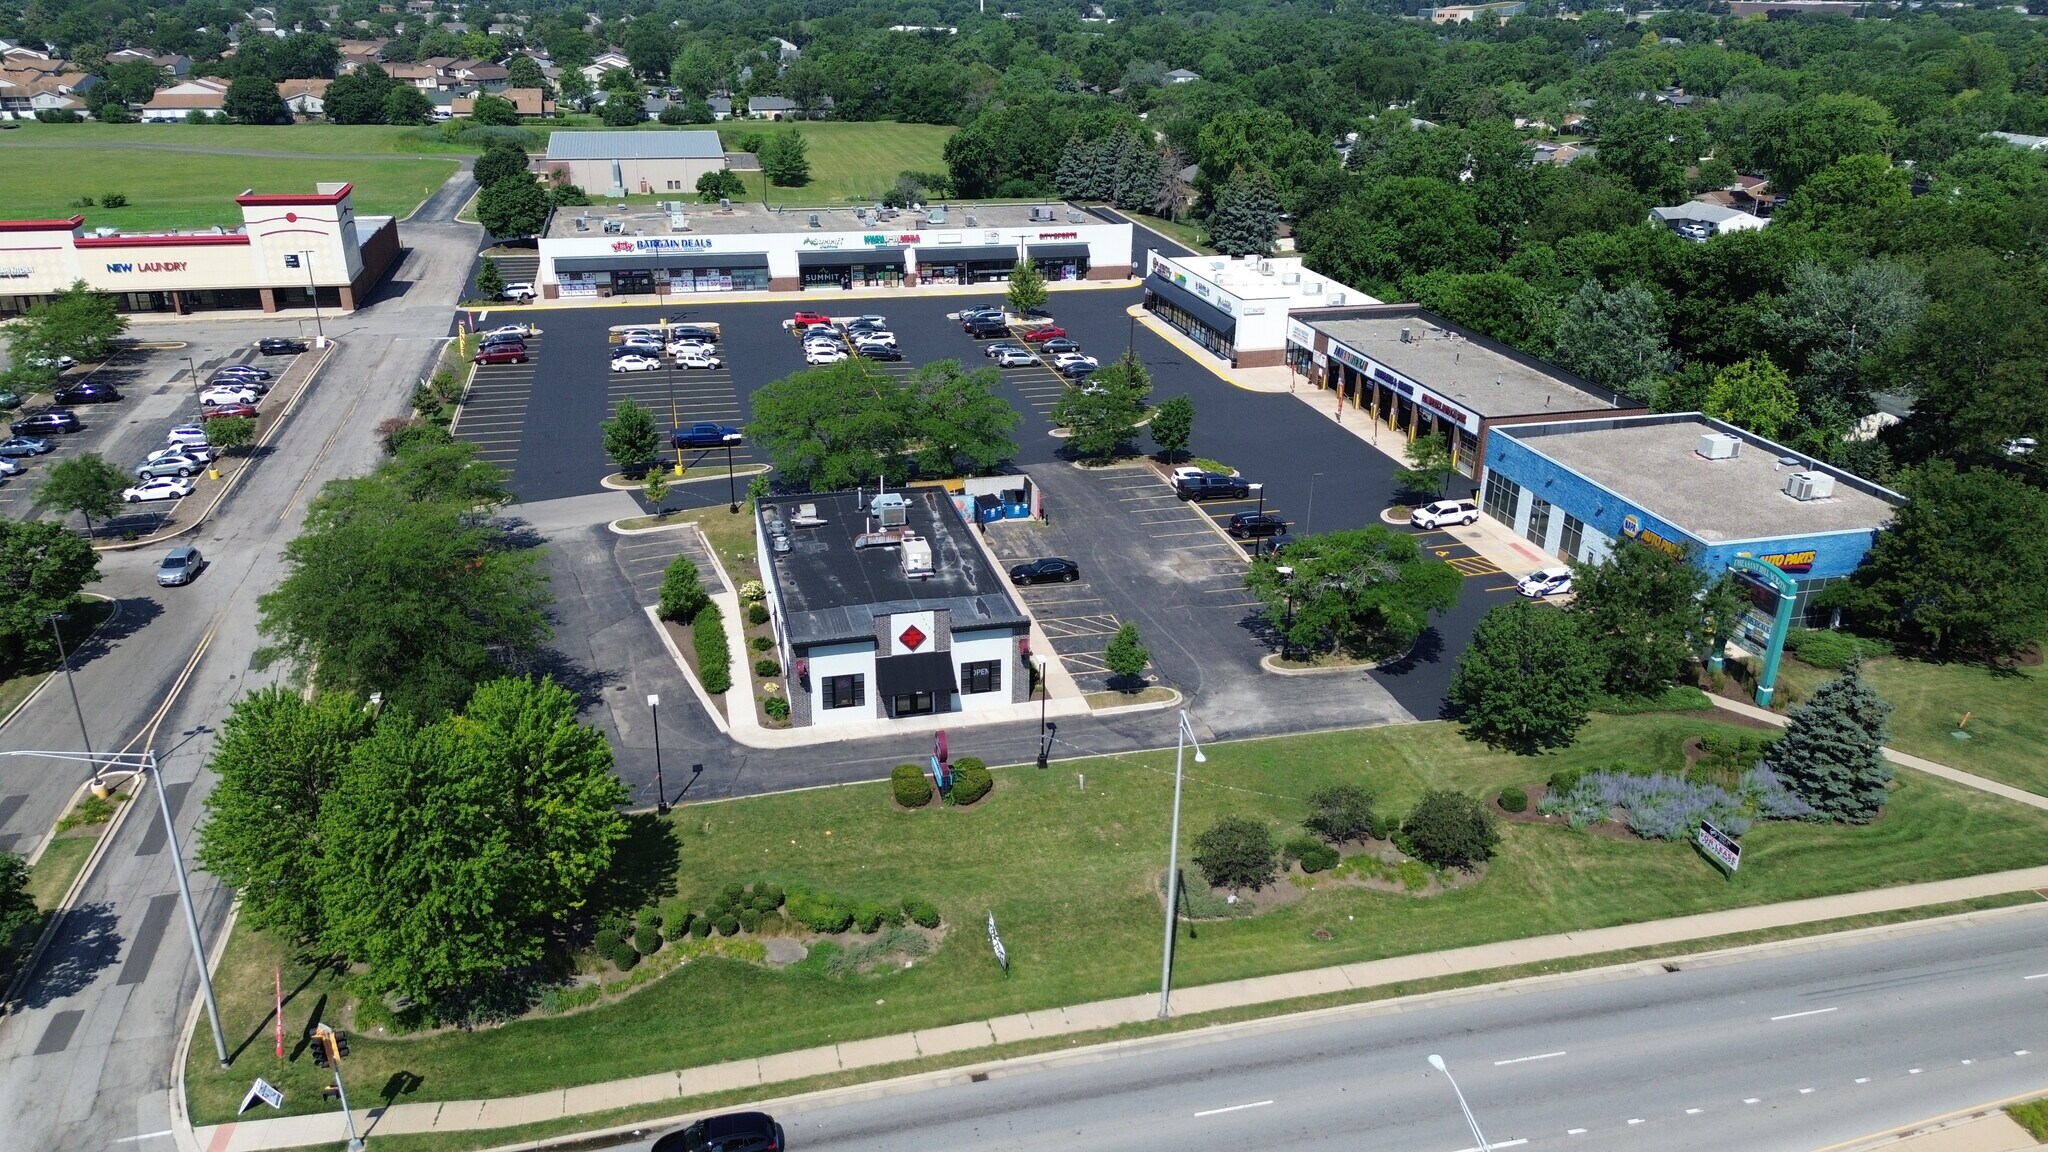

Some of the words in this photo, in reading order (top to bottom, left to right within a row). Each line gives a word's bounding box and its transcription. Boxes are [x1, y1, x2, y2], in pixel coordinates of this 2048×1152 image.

[637, 239, 680, 250] BARGAIN
[681, 238, 712, 248] DEALS
[106, 263, 133, 274] NEW
[137, 261, 188, 273] LAUNDRY
[805, 273, 840, 281] SUMMIT
[1624, 519, 1637, 534] NAPA
[1641, 528, 1662, 547] AUTO
[1784, 551, 1817, 566] PARTS
